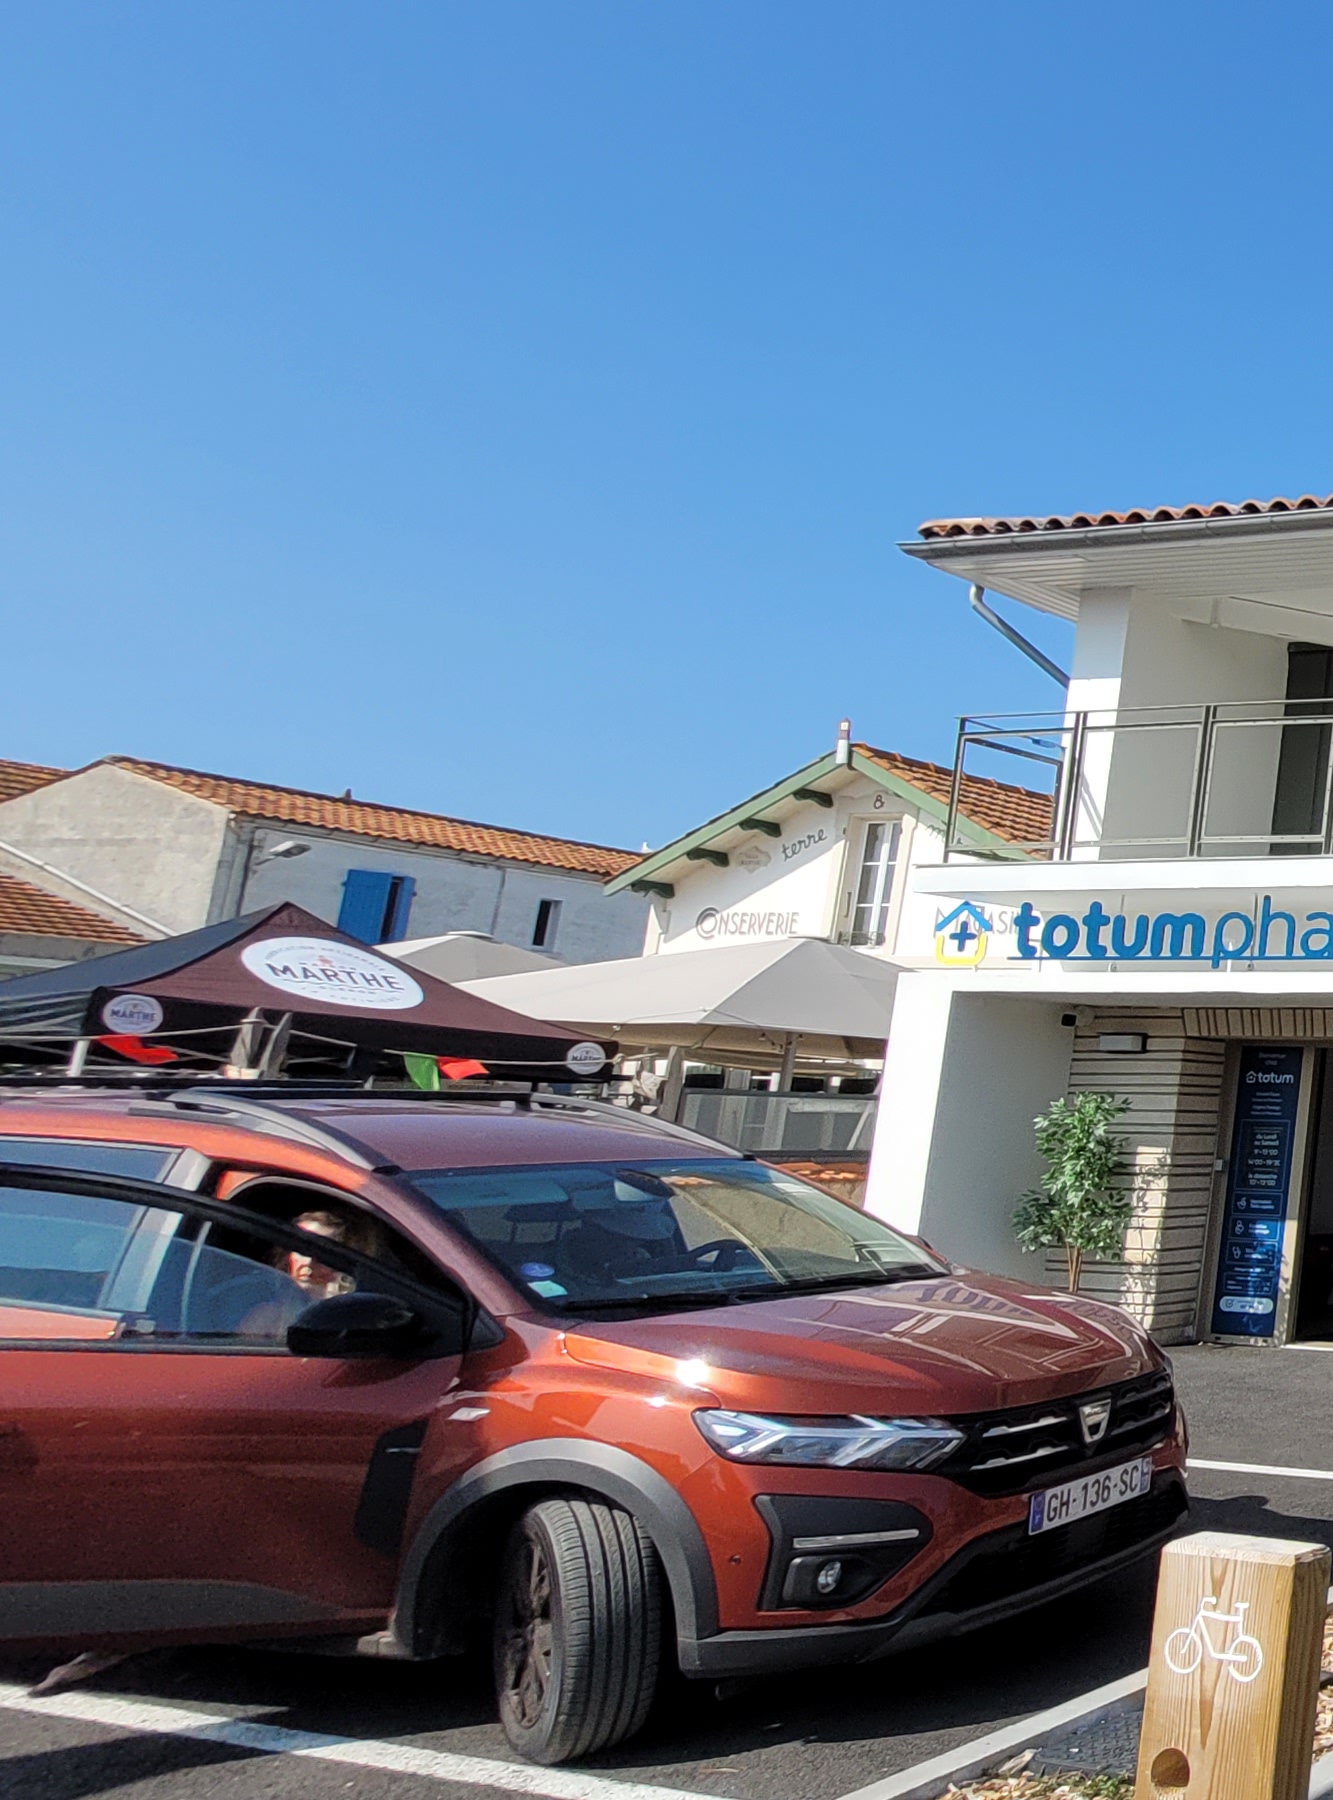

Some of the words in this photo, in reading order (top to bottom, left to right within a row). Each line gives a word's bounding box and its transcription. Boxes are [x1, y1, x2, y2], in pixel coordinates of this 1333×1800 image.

[873, 794, 885, 809] &
[781, 828, 828, 862] terre
[265, 963, 405, 991] MARTHE
[109, 1008, 156, 1022] MARTHE
[1257, 1071, 1295, 1084] totum
[1045, 1464, 1140, 1523] GH-136-SC
